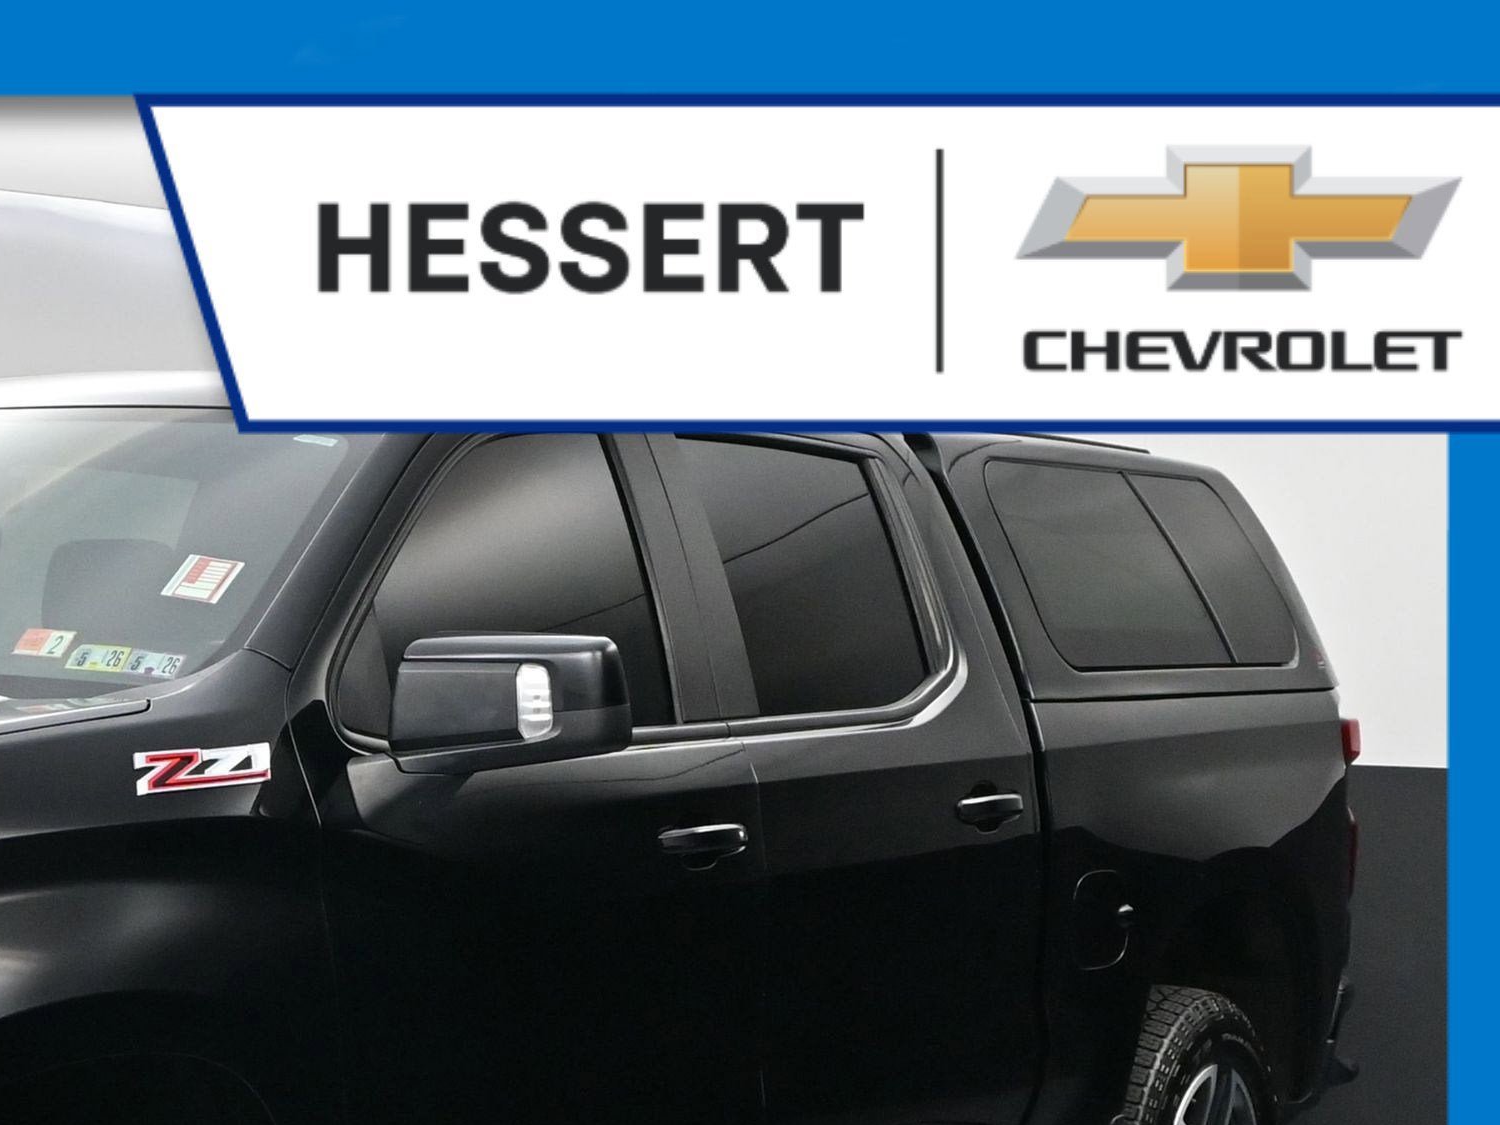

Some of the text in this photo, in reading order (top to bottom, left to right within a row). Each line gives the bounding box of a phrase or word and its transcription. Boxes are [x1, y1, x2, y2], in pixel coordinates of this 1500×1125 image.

[105, 649, 125, 667] 26
[161, 656, 180, 674] 26
[133, 741, 272, 797] Z71
